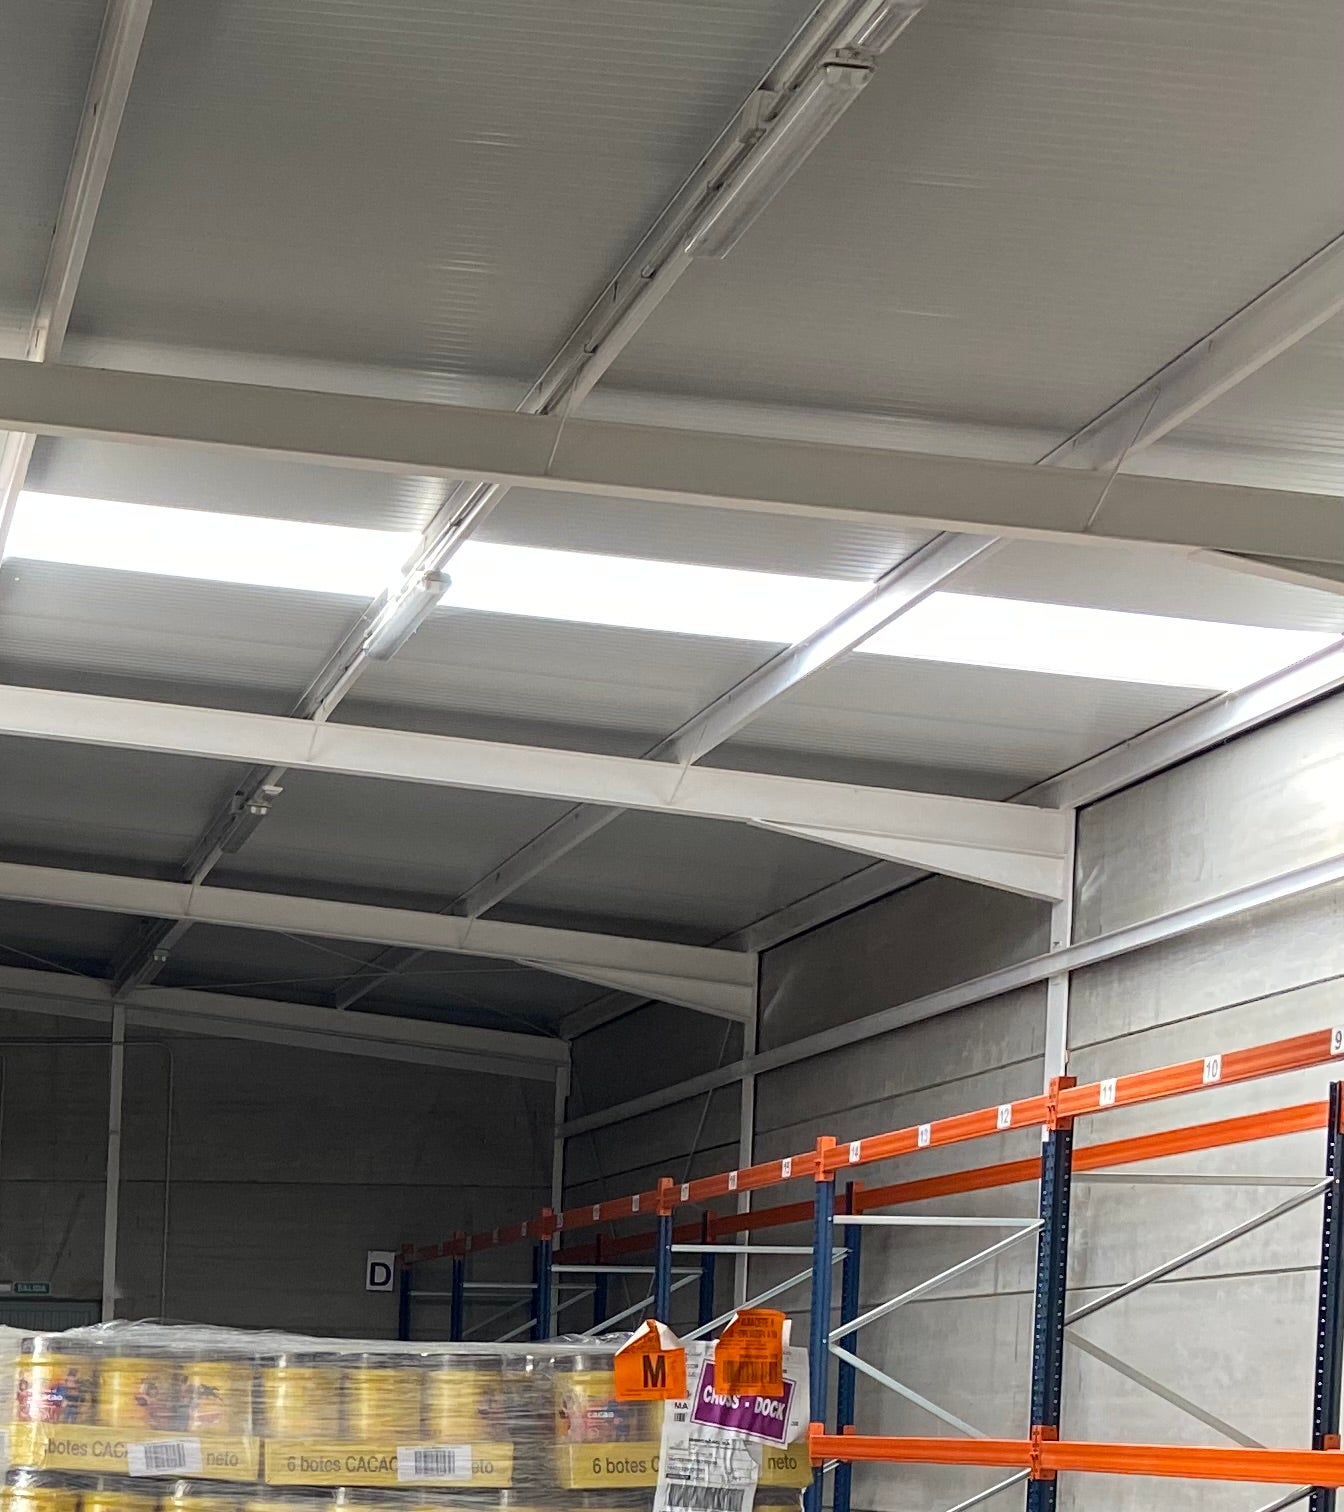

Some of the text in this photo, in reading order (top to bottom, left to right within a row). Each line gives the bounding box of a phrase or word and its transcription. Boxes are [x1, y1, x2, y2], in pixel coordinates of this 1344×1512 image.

[1335, 1030, 1342, 1050] 9
[1206, 1058, 1218, 1078] 10
[1102, 1084, 1112, 1101] 11
[1000, 1108, 1009, 1124] 12
[369, 1262, 392, 1287] D
[643, 1354, 666, 1388] M
[754, 1396, 786, 1421] DOCK
[48, 1438, 238, 1467] botes neto
[288, 1456, 341, 1472] 6 botes
[592, 1456, 798, 1474] 6 botes neto
